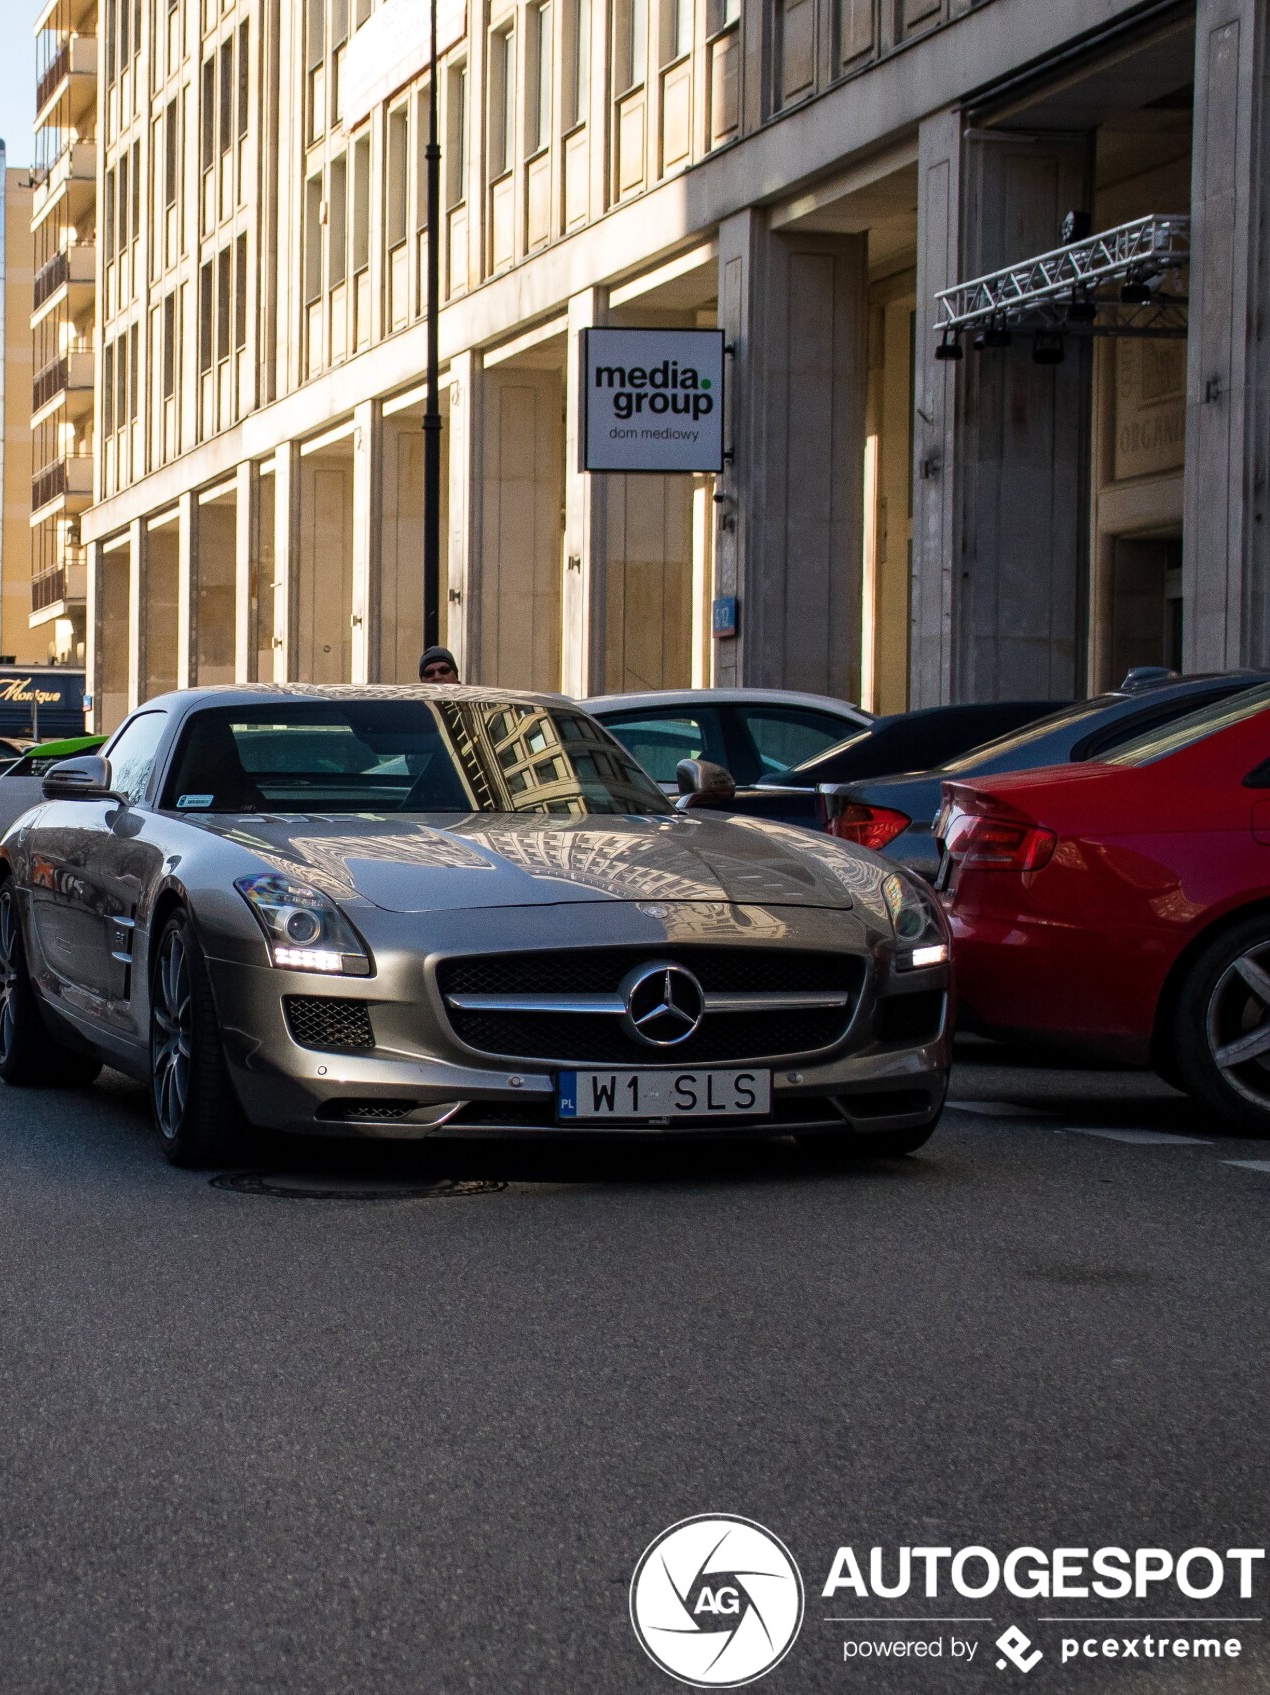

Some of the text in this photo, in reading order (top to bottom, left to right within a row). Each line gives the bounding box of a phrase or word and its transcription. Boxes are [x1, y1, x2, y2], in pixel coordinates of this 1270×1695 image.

[613, 392, 714, 421] group
[609, 426, 699, 442] dom mediowy
[561, 1073, 757, 1112] PL W1 SLS
